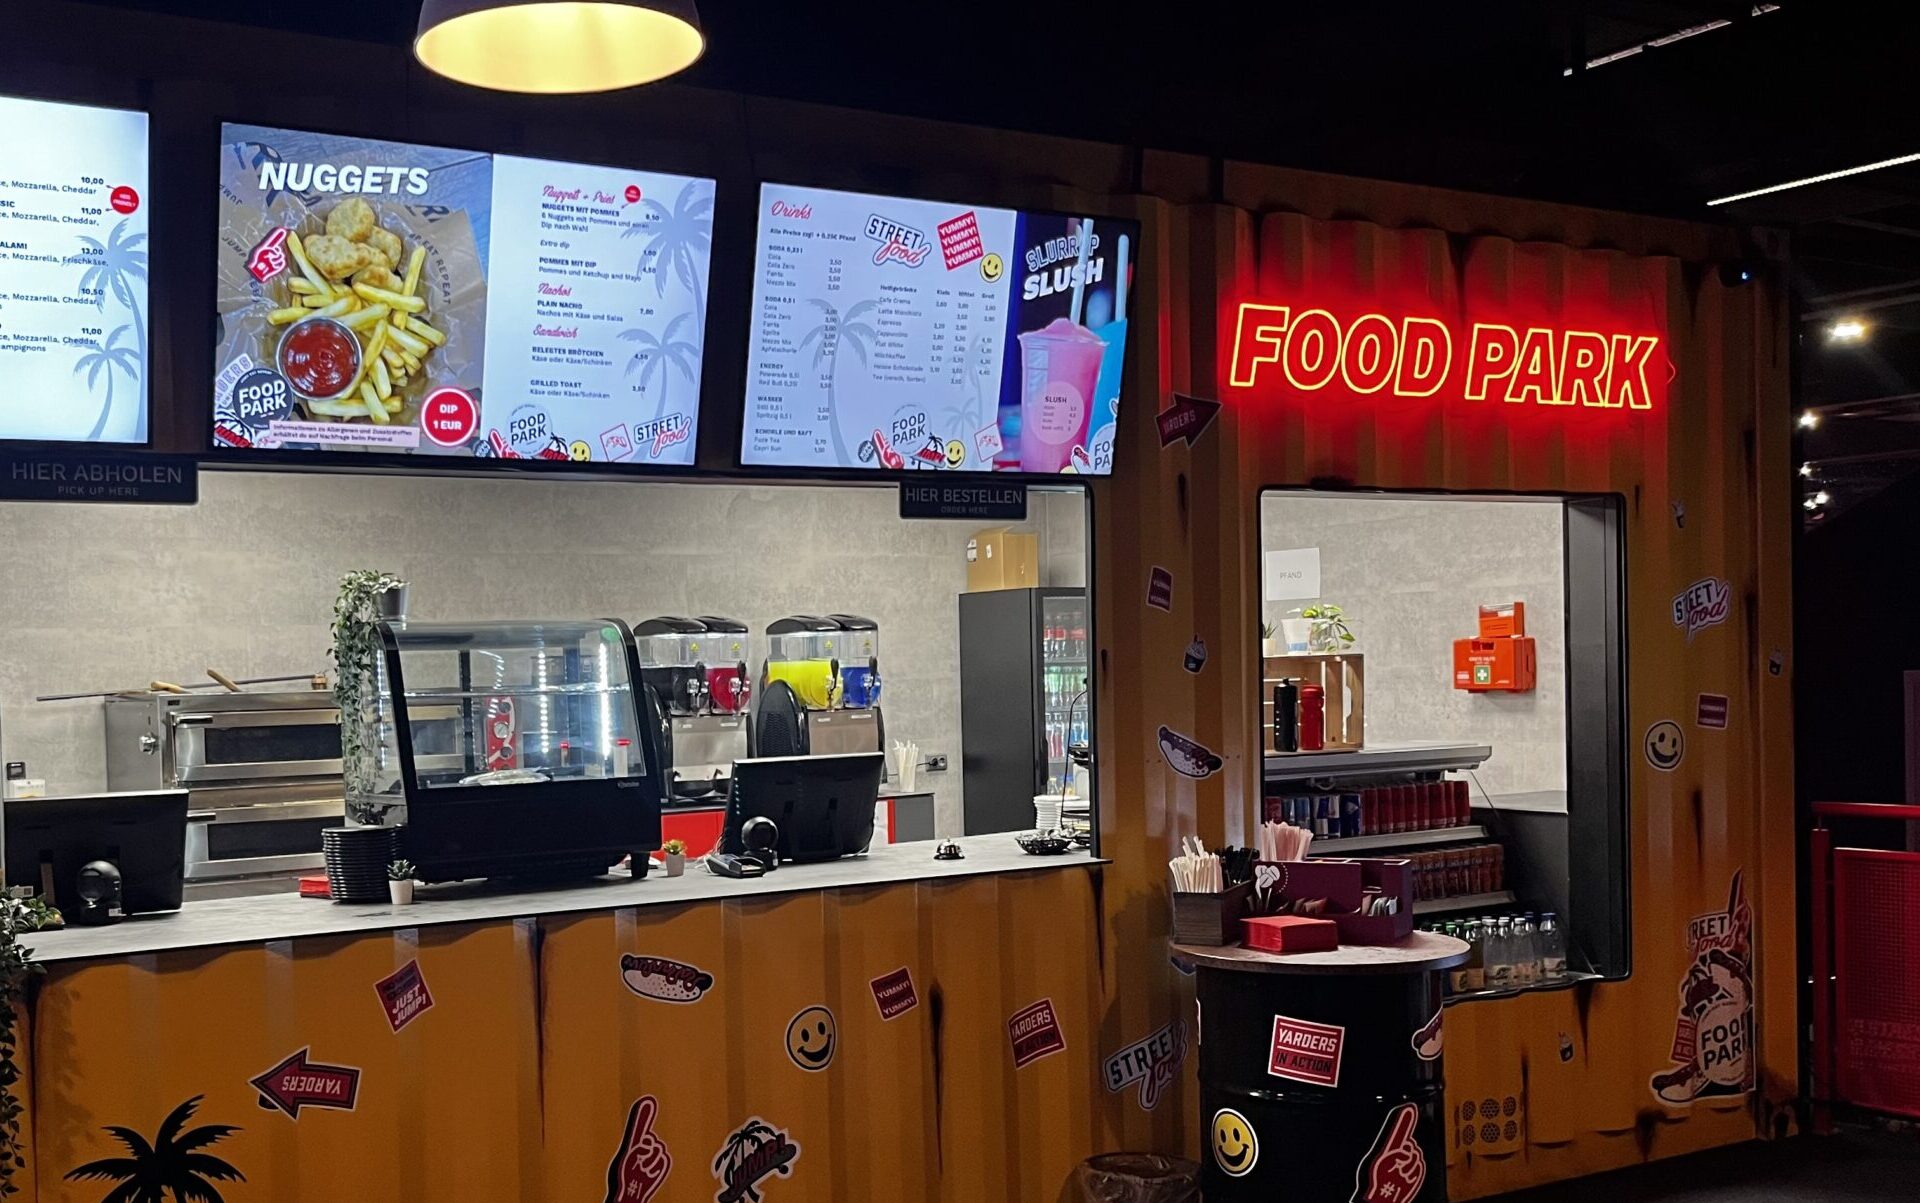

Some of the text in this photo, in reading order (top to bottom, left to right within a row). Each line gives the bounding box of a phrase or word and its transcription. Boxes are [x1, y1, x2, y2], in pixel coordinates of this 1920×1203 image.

[12, 180, 97, 195] Mozzarella, Cheddar
[81, 176, 104, 185] 10,00
[258, 161, 429, 196] NUGGETS
[12, 212, 100, 226] Mozzarella, Cheddar,
[81, 207, 102, 216] 11,00
[542, 203, 620, 217] NUGGETS MIT POMMES
[548, 213, 574, 222] Nuggets
[589, 217, 617, 226] Pommes
[771, 200, 812, 219] Drinks
[572, 224, 588, 232] Wahl
[869, 217, 921, 249] STREET
[940, 215, 976, 237] YUMMY!
[540, 239, 570, 250] Extra dip
[942, 226, 978, 248] YUMMY!
[944, 237, 980, 258] YUMMY!
[12, 252, 60, 264] Mozzarella,
[876, 237, 929, 263] food
[946, 247, 982, 268] YUMMY!
[539, 257, 569, 266] POMMES
[539, 266, 567, 275] Pommes
[1023, 257, 1104, 301] SLUSH
[12, 293, 100, 306] Mozzarella, Cheddar,
[537, 299, 583, 309] PLAIN NACHO
[537, 309, 561, 317] Nachos
[13, 334, 60, 344] Mozzarella,
[1228, 302, 1660, 410] FOOD PARK
[239, 380, 286, 403] FOOD
[530, 379, 559, 387] GRILLED
[240, 393, 287, 418] PARK
[439, 403, 458, 414] DIP
[1045, 395, 1067, 403] SLUSH
[433, 420, 462, 431] 1 EUR
[510, 412, 546, 434] FOOD
[637, 415, 680, 441] STREET
[892, 412, 926, 433] FOOD
[511, 423, 547, 446] PARK
[653, 420, 690, 456] food
[892, 423, 926, 446] PARK
[12, 462, 183, 484] HIER ABHOLEN
[58, 485, 140, 497] PICK UP HERE
[905, 487, 1023, 504] HIER BESTELLEN
[392, 983, 421, 1014] JUST
[877, 979, 910, 1000] YUMMY!
[394, 992, 427, 1026] JUMP!
[882, 995, 914, 1016] YUMMY!
[1279, 1027, 1338, 1053] YARDERS
[1276, 1052, 1332, 1074] IN ACTION
[281, 1075, 341, 1095] YARDERS
[626, 1179, 644, 1200] #1
